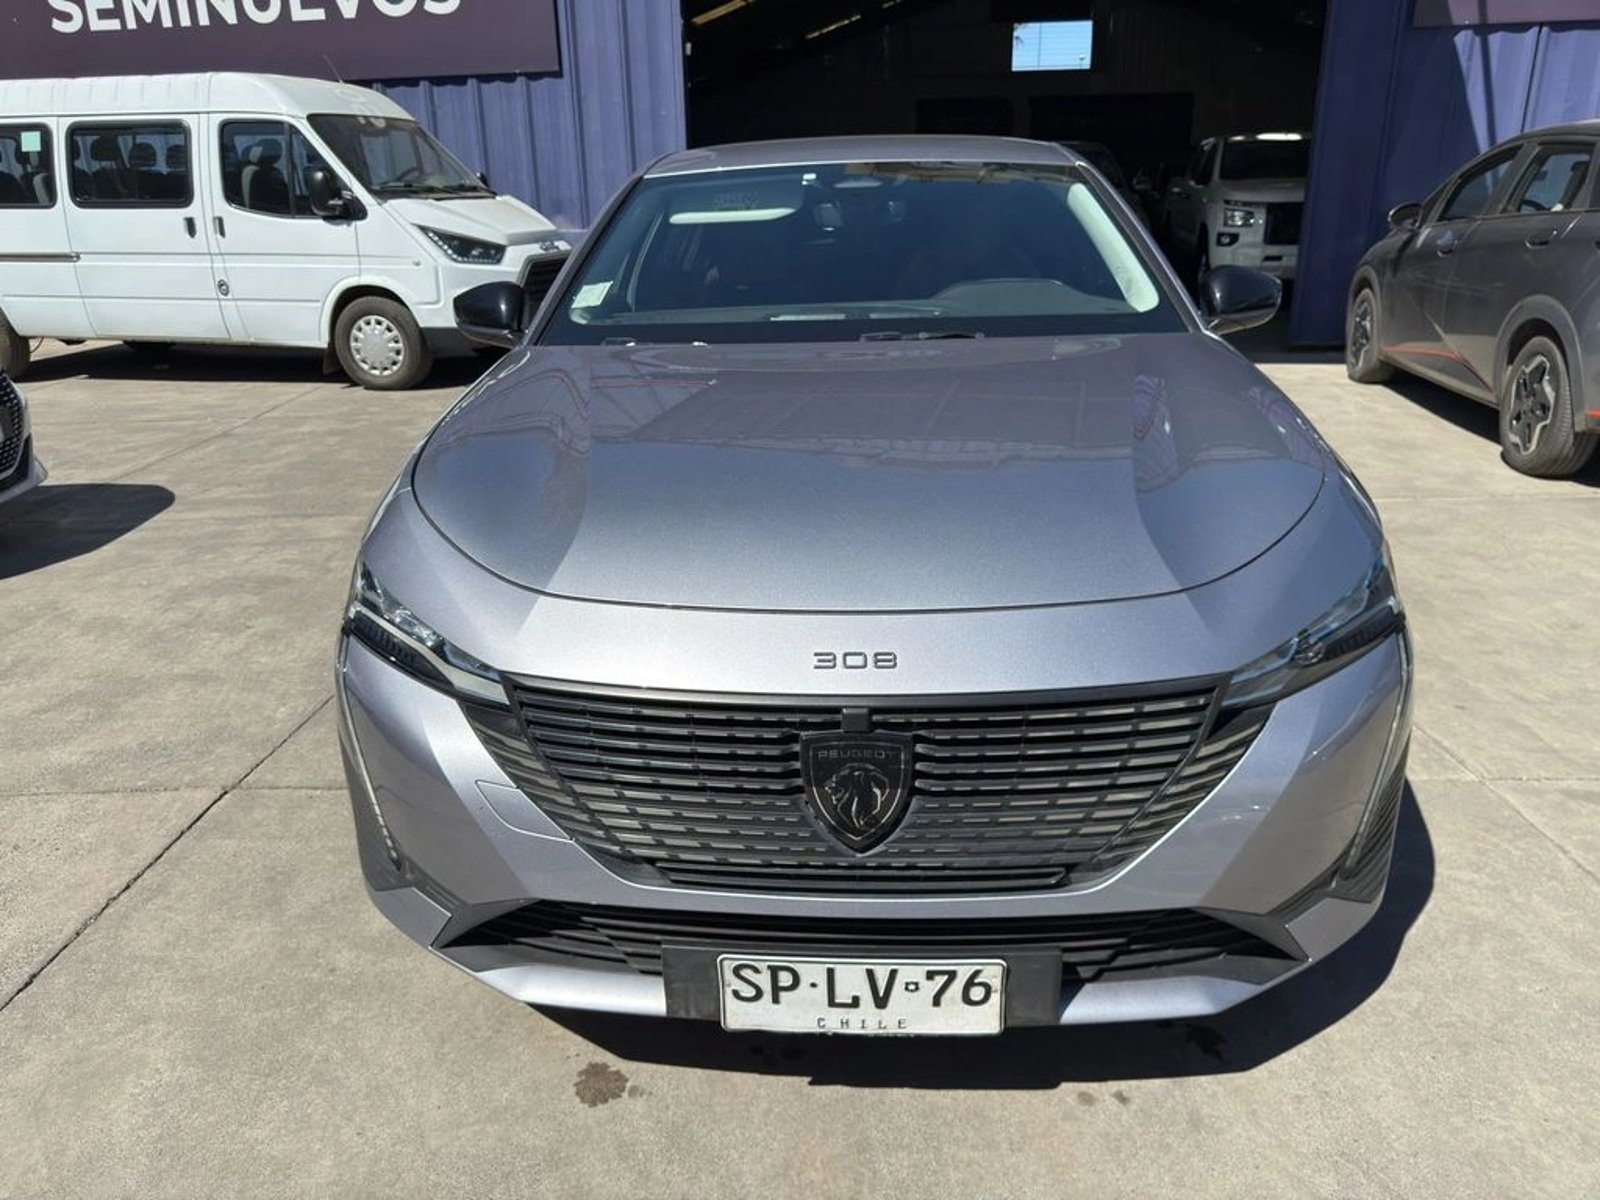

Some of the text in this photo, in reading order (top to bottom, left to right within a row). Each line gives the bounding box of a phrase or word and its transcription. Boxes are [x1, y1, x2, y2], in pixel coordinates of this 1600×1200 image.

[49, 0, 461, 34] SEMIN
[813, 651, 898, 670] 308
[816, 1016, 908, 1030] CHILE
